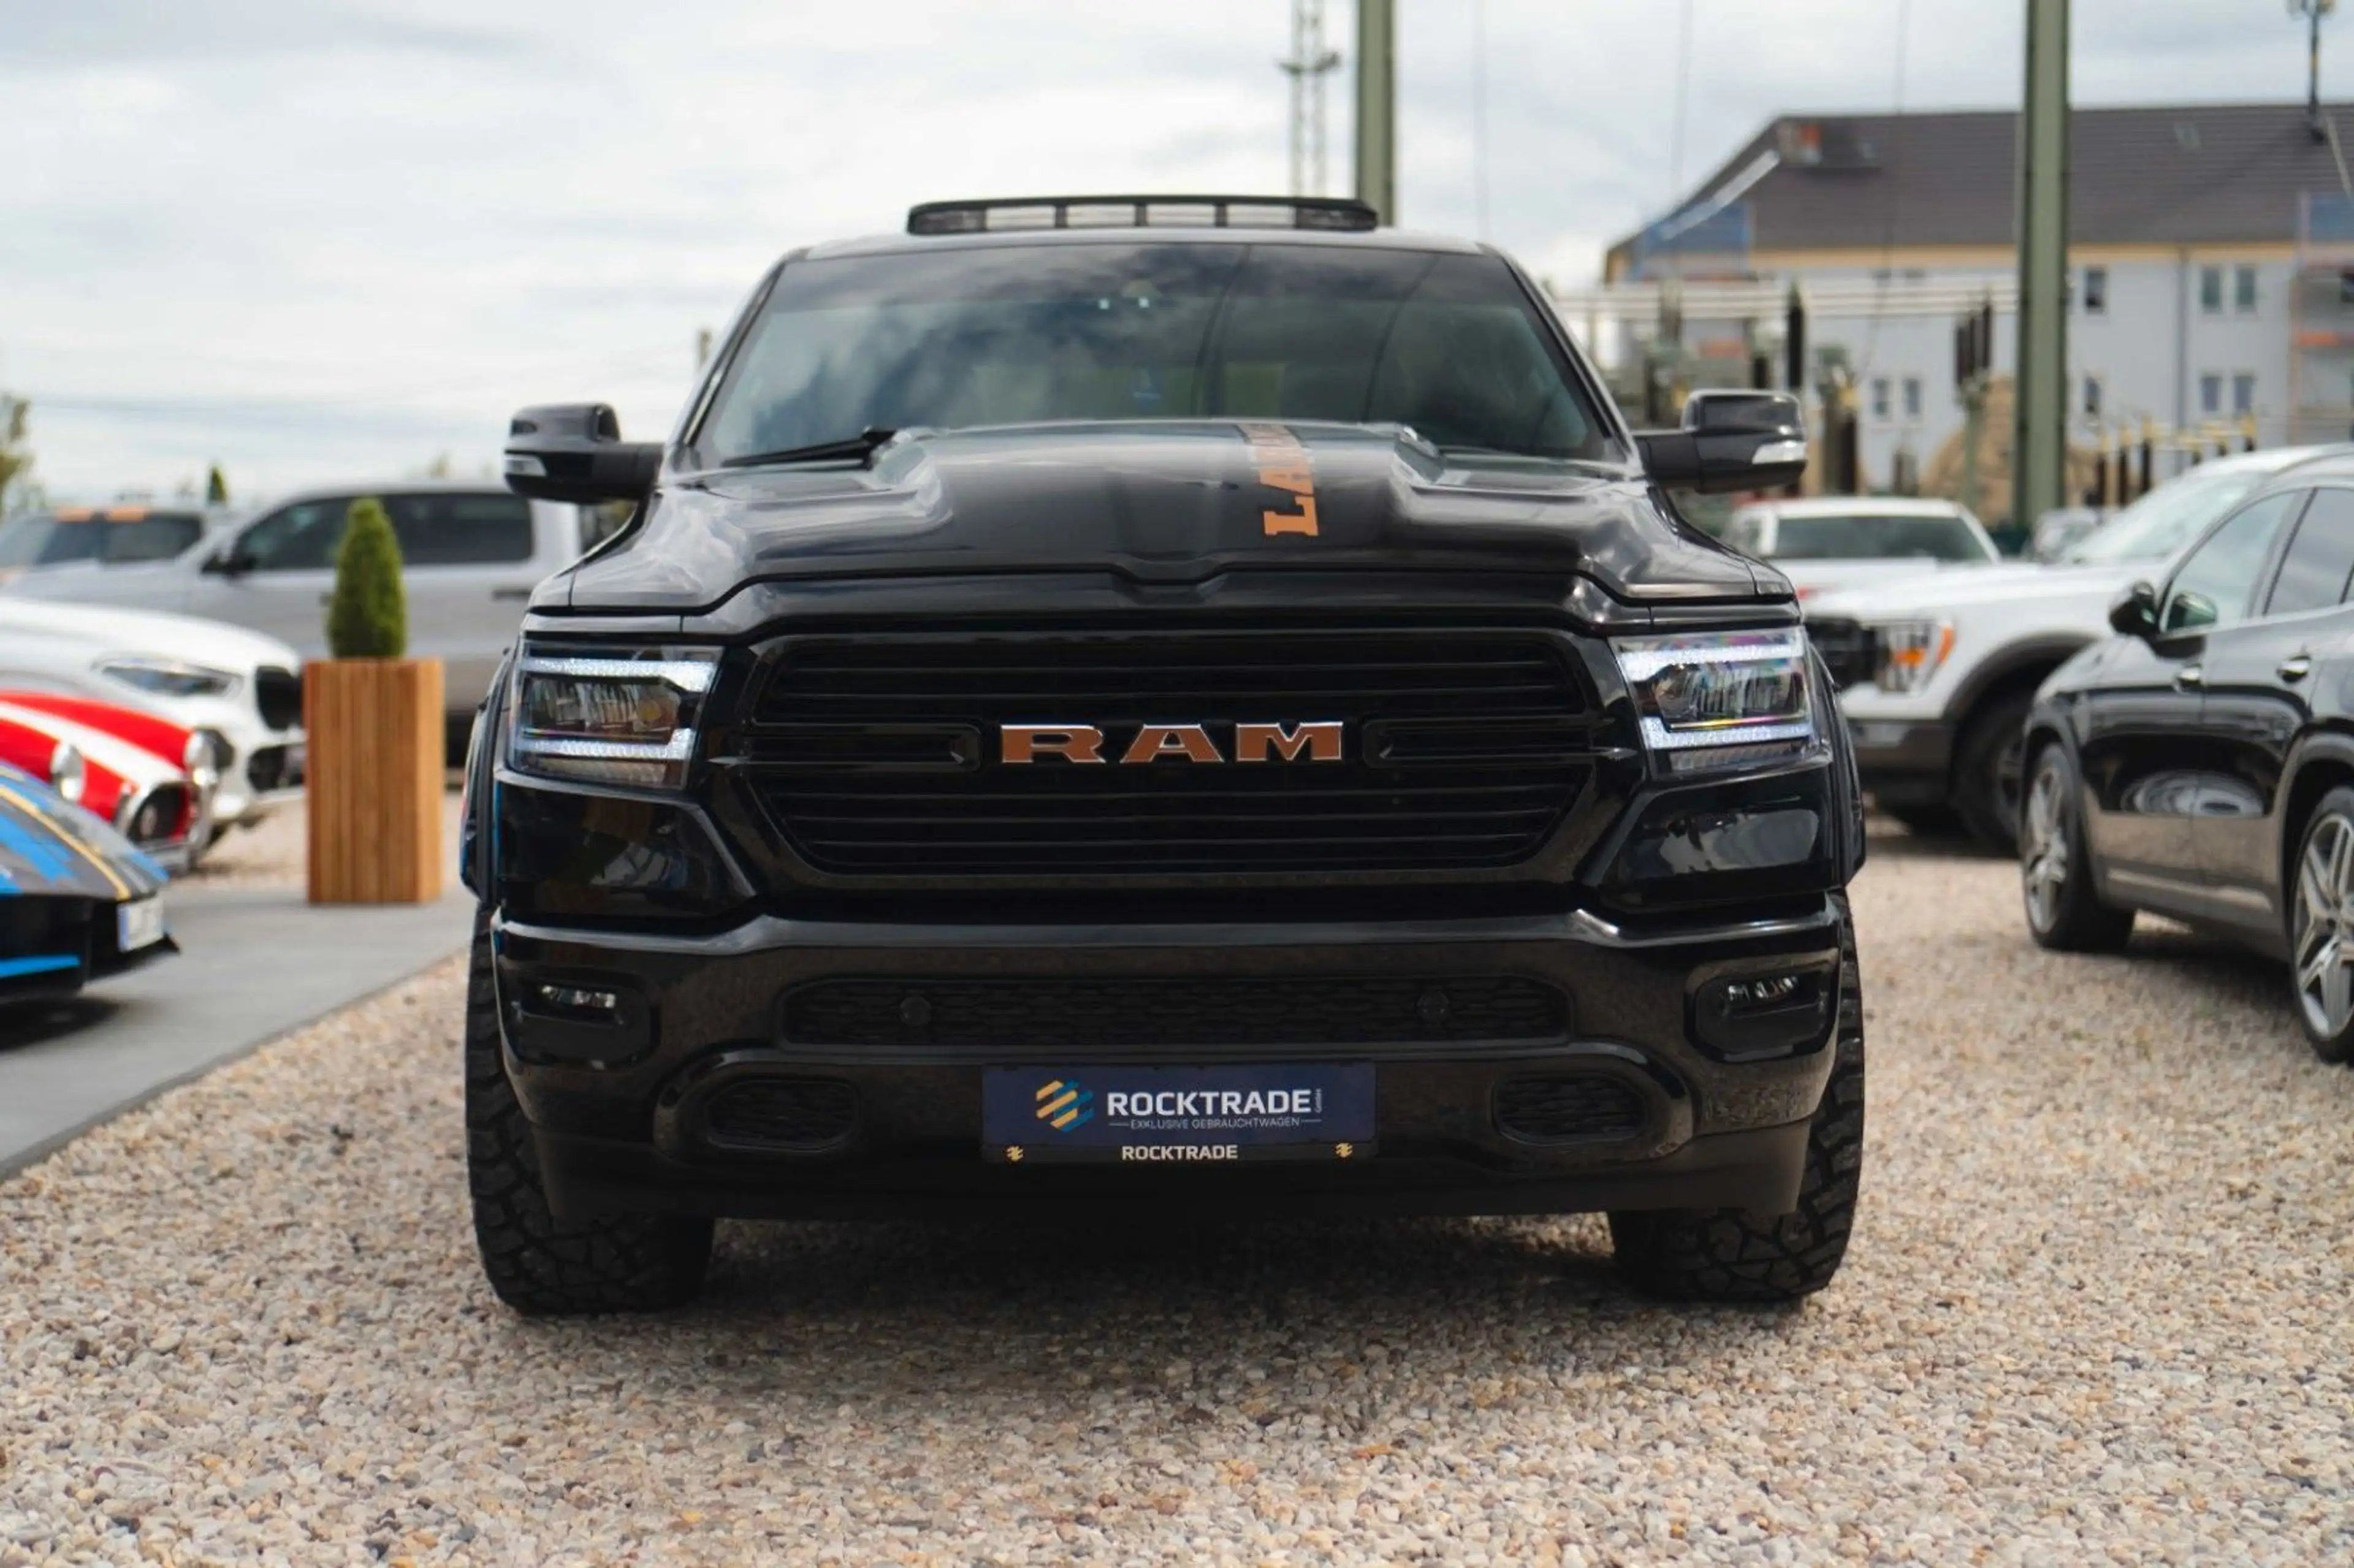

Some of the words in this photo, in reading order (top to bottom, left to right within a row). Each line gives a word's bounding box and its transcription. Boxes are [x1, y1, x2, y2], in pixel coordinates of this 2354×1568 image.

[1000, 721, 1344, 764] RAM
[1107, 1089, 1311, 1116] ROCKTRADE
[1130, 1119, 1189, 1130] EXKLUSIVE
[1191, 1117, 1300, 1128] GEBRAUCHTWAGEN
[1122, 1144, 1238, 1160] ROCKTRADE
